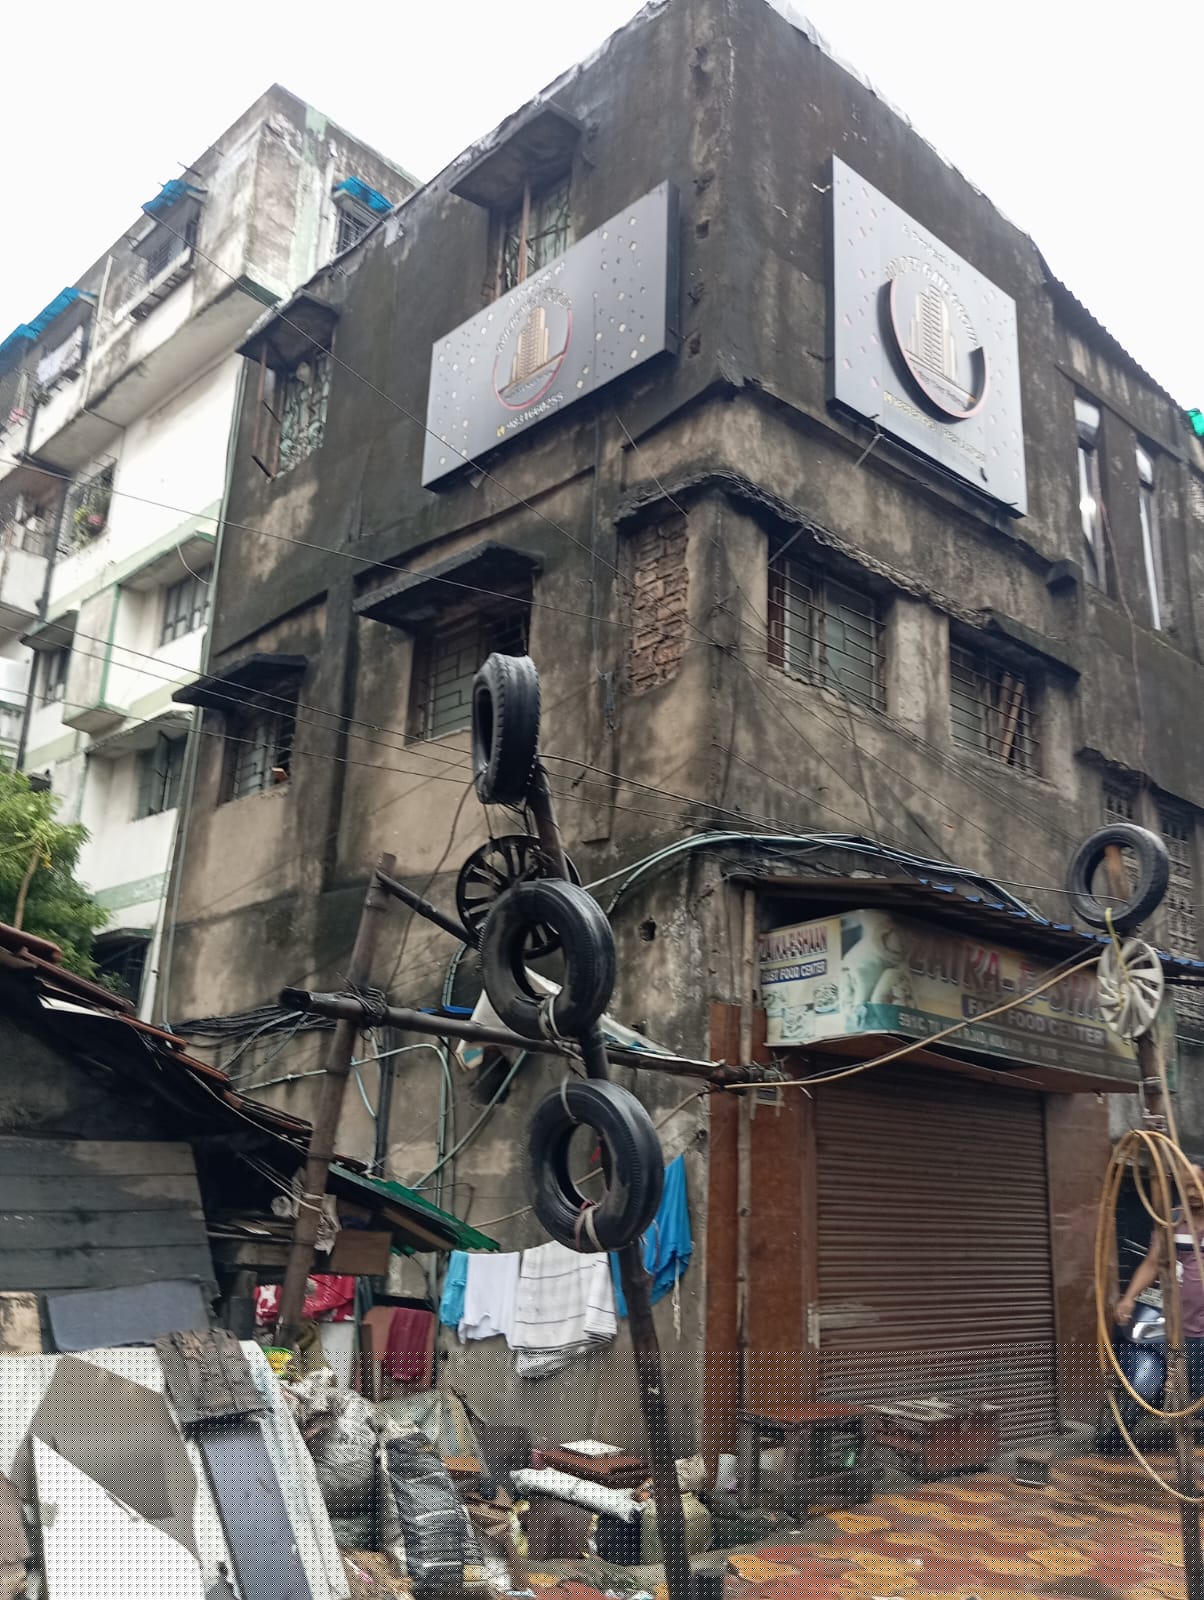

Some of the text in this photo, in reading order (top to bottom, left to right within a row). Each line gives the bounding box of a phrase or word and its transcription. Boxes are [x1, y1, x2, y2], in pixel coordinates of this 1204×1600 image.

[780, 966, 800, 980] FOOD
[801, 961, 826, 977] CENTER
[1007, 1008, 1046, 1031] FOOD
[1047, 1019, 1105, 1046] CENTER
